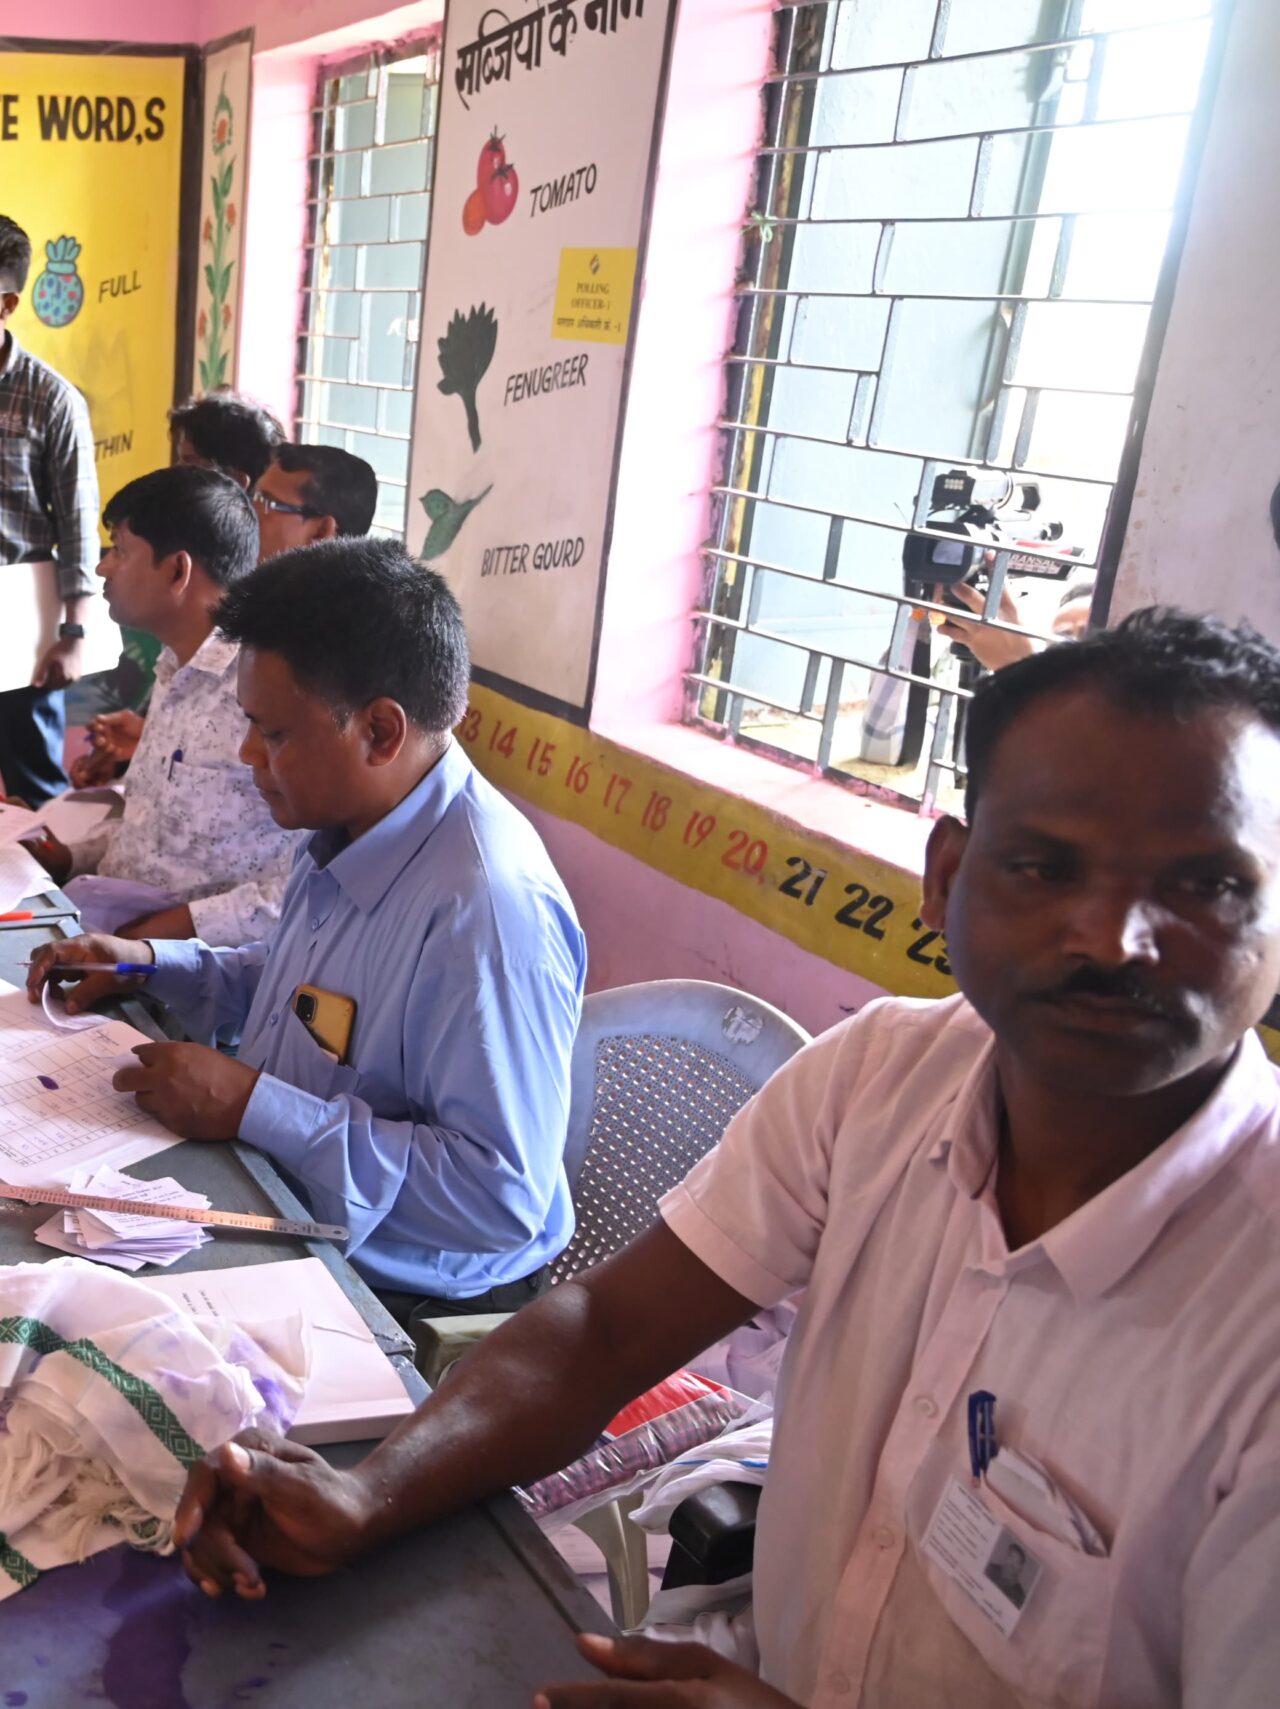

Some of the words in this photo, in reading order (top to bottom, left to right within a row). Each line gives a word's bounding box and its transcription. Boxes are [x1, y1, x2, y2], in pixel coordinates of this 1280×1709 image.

[530, 163, 597, 218] TOMATO
[98, 269, 142, 304] FULL
[576, 282, 610, 295] POLLING
[503, 353, 589, 407] FENUGREER
[95, 430, 133, 462] THIN
[481, 543, 530, 577] BITTER
[532, 536, 585, 571] GOURD
[488, 719, 518, 759] 14
[526, 736, 557, 776] 15
[565, 755, 593, 794] 16
[603, 772, 633, 815] 17
[641, 789, 672, 832] 18
[683, 810, 717, 848] 19
[778, 856, 828, 906] 21
[834, 882, 894, 941] 22
